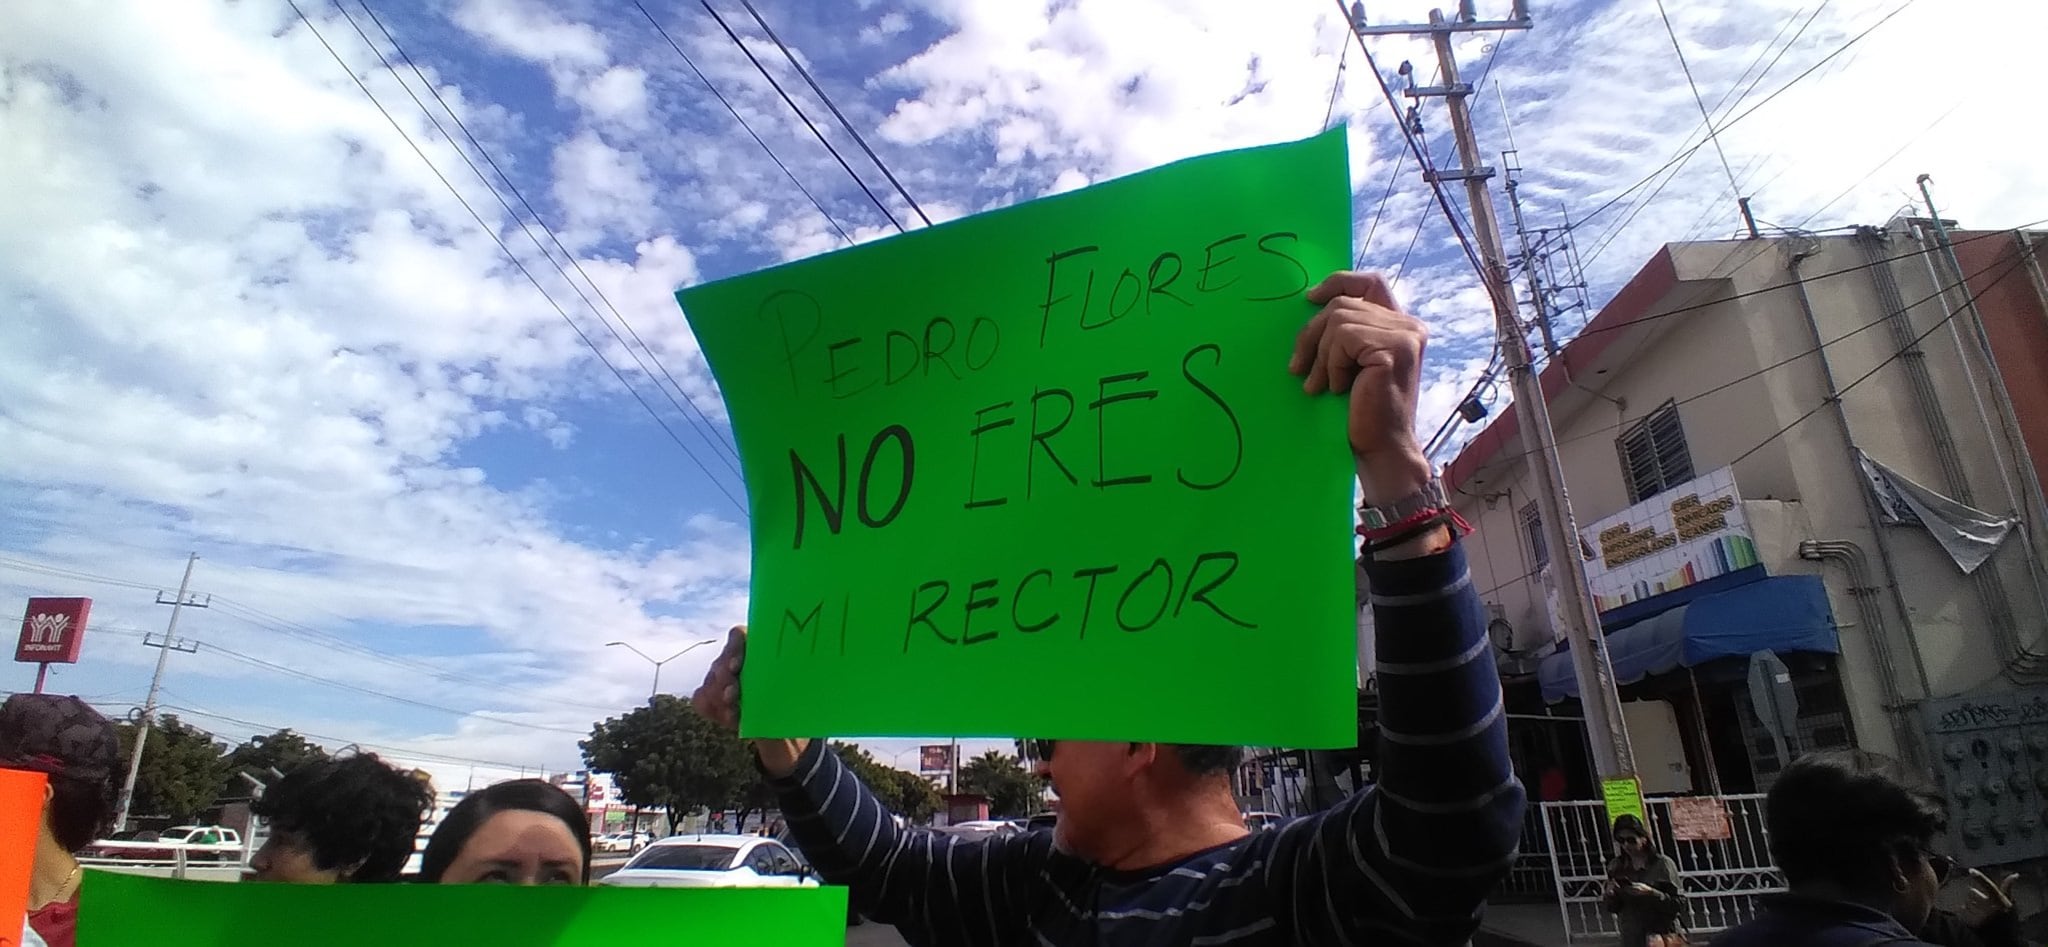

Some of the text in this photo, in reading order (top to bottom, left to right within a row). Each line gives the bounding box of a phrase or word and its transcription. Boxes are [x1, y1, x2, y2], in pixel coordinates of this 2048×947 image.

[757, 232, 1310, 400] PEDRO FLORES
[789, 344, 1243, 549] NO ERES
[1679, 514, 1727, 543] SCANNER
[780, 551, 1258, 656] MI RECTOR
